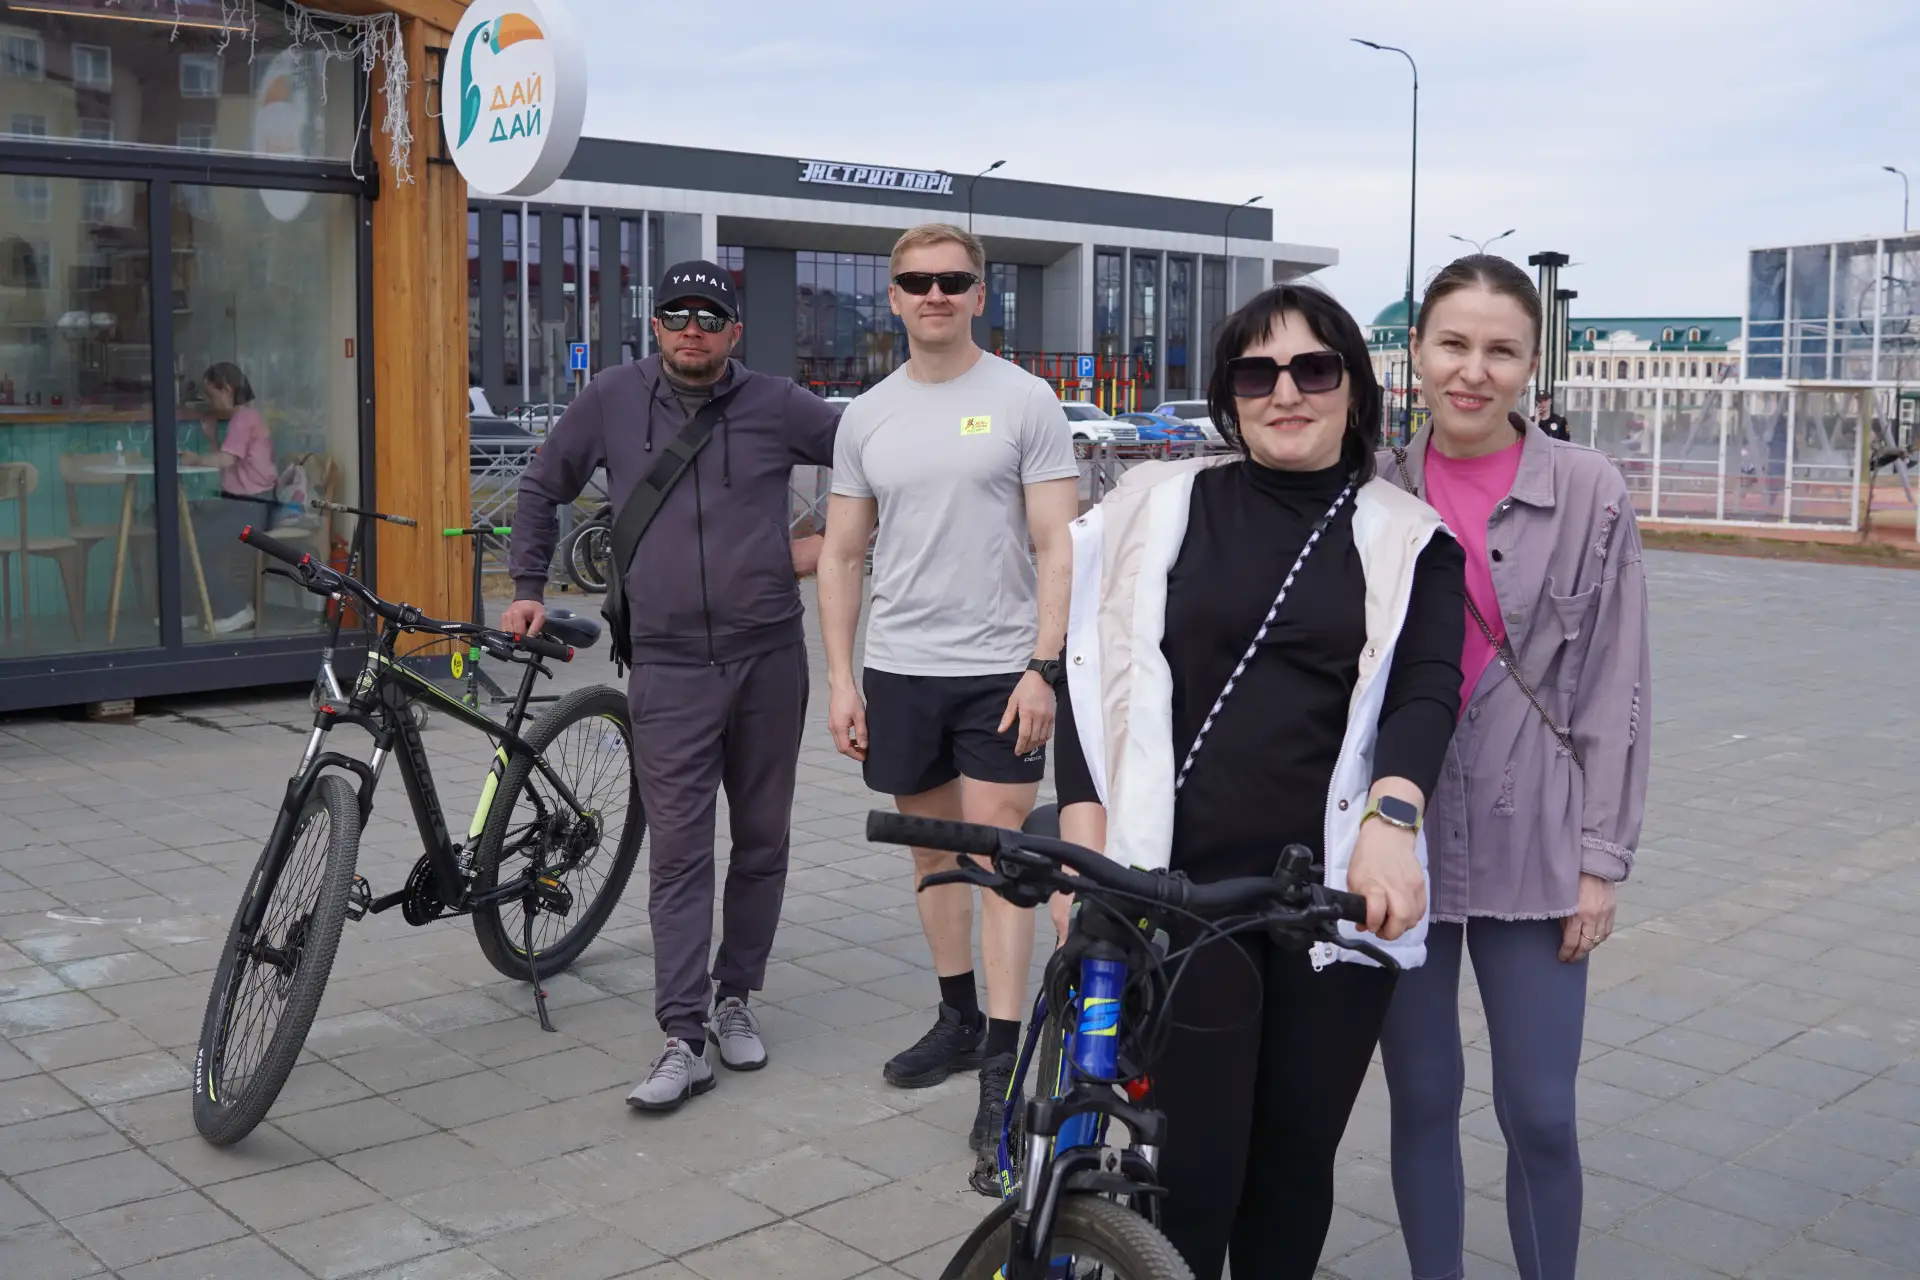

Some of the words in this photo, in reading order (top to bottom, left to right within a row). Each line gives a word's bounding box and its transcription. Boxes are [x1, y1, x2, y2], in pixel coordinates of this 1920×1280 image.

[489, 72, 541, 111] ДАЙ
[489, 104, 541, 142] ДАЙ
[798, 160, 898, 186] ЭКСТРИМ
[901, 171, 954, 194] ПАРК
[673, 273, 728, 292] YAMAL
[195, 1048, 204, 1094] KENDA
[1001, 1169, 1012, 1196] STELS
